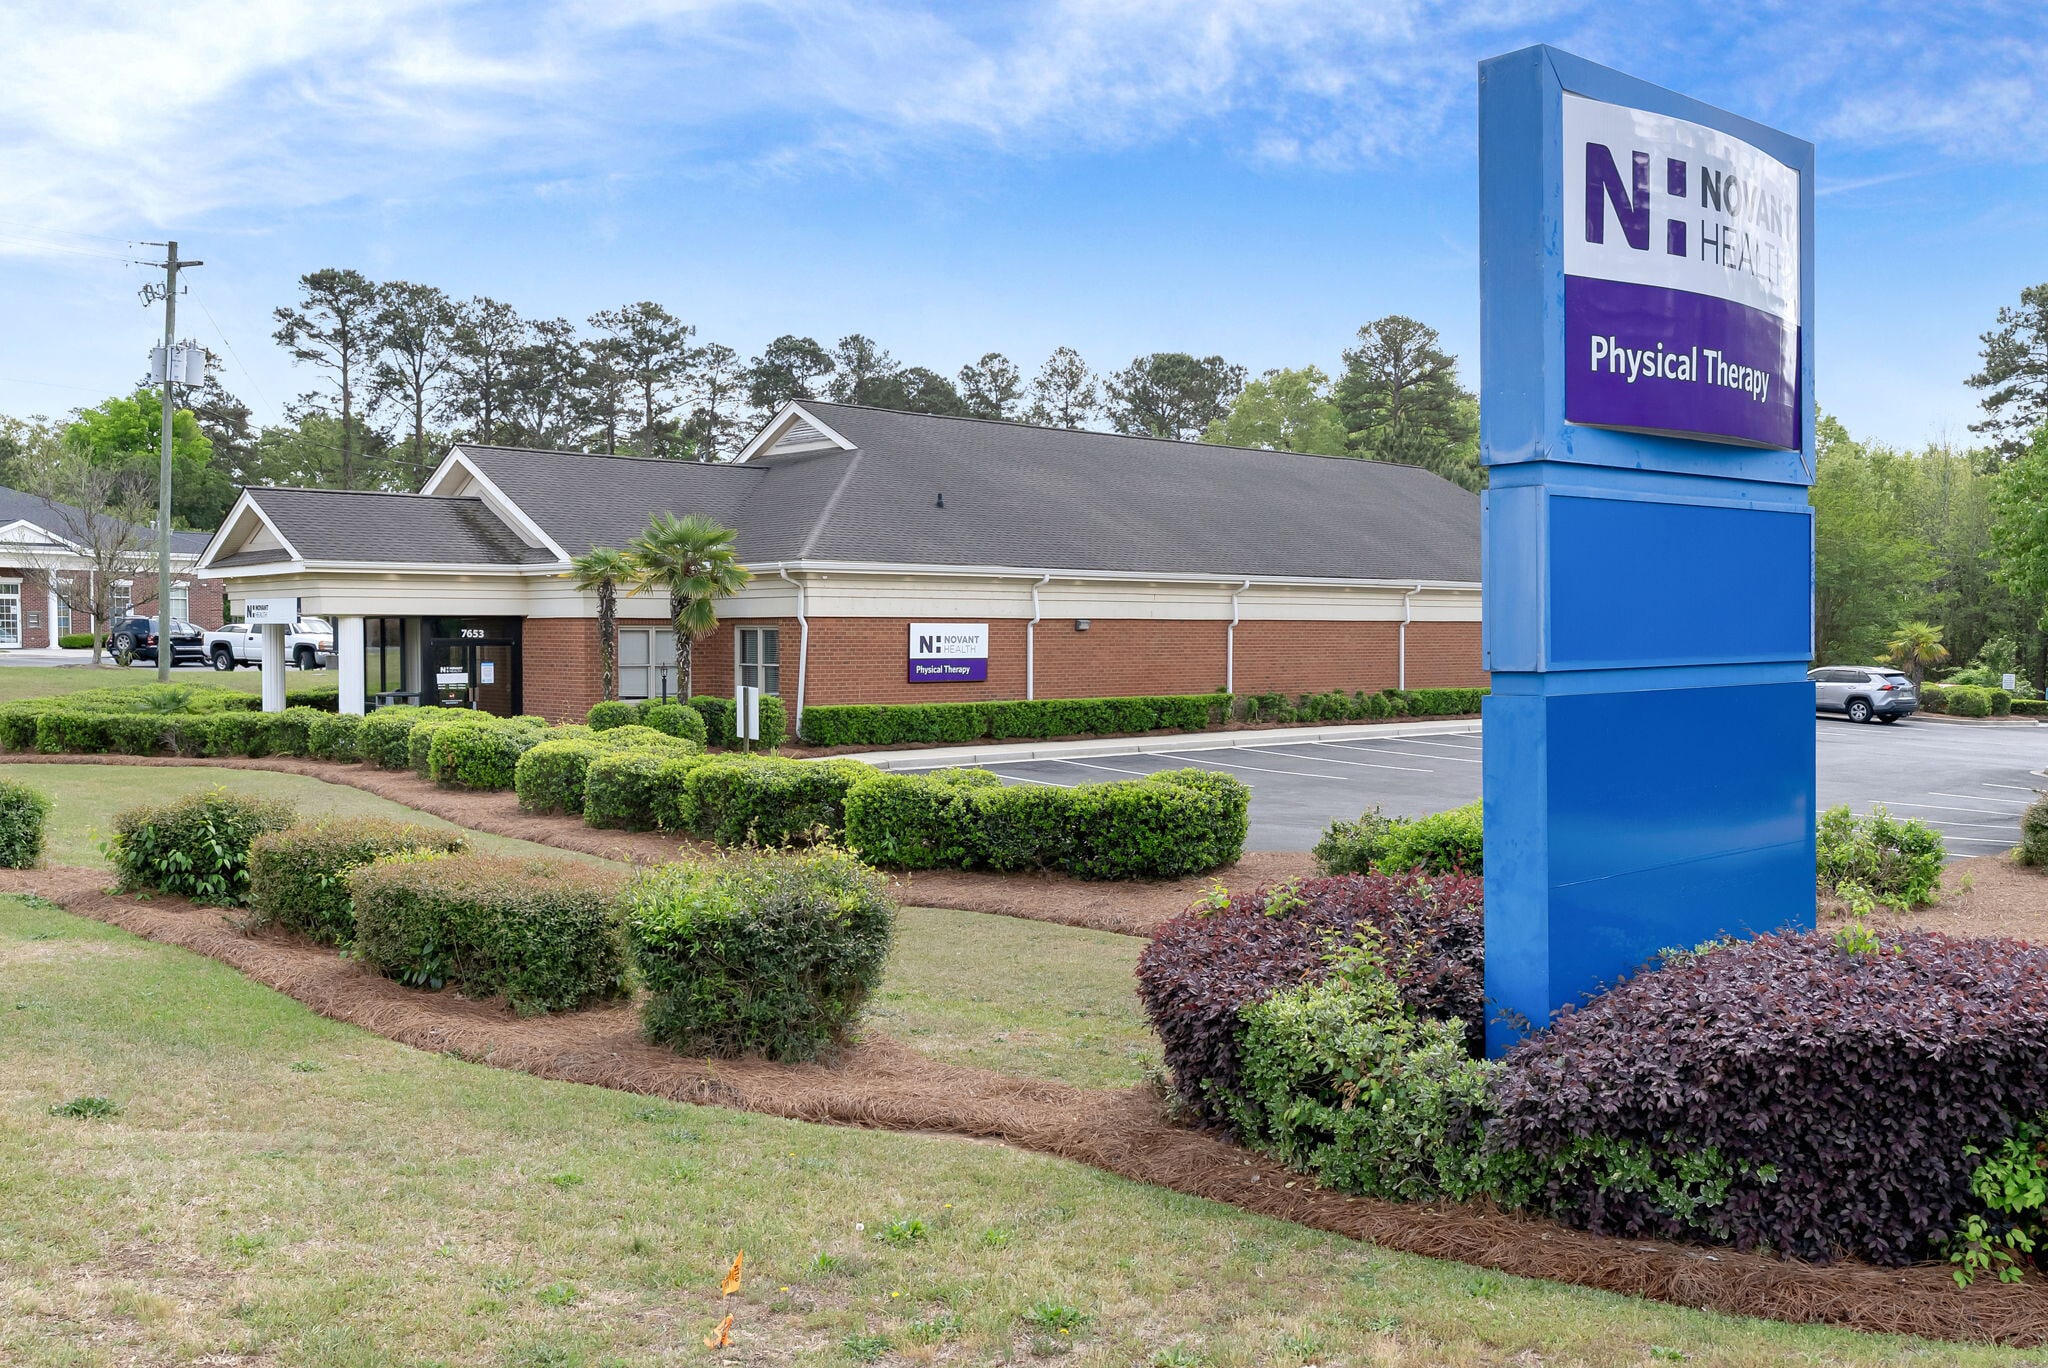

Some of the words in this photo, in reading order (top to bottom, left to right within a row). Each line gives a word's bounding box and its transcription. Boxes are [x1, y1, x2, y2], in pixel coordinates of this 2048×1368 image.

[1701, 166, 1793, 242] NOVANT
[1591, 335, 1698, 384] Physical
[1703, 348, 1770, 403] Therapy
[461, 629, 485, 638] 7653
[944, 635, 980, 644] NOVANT
[944, 645, 977, 653] HEALTH
[916, 665, 943, 675] Physical
[944, 665, 971, 675] Therapy
